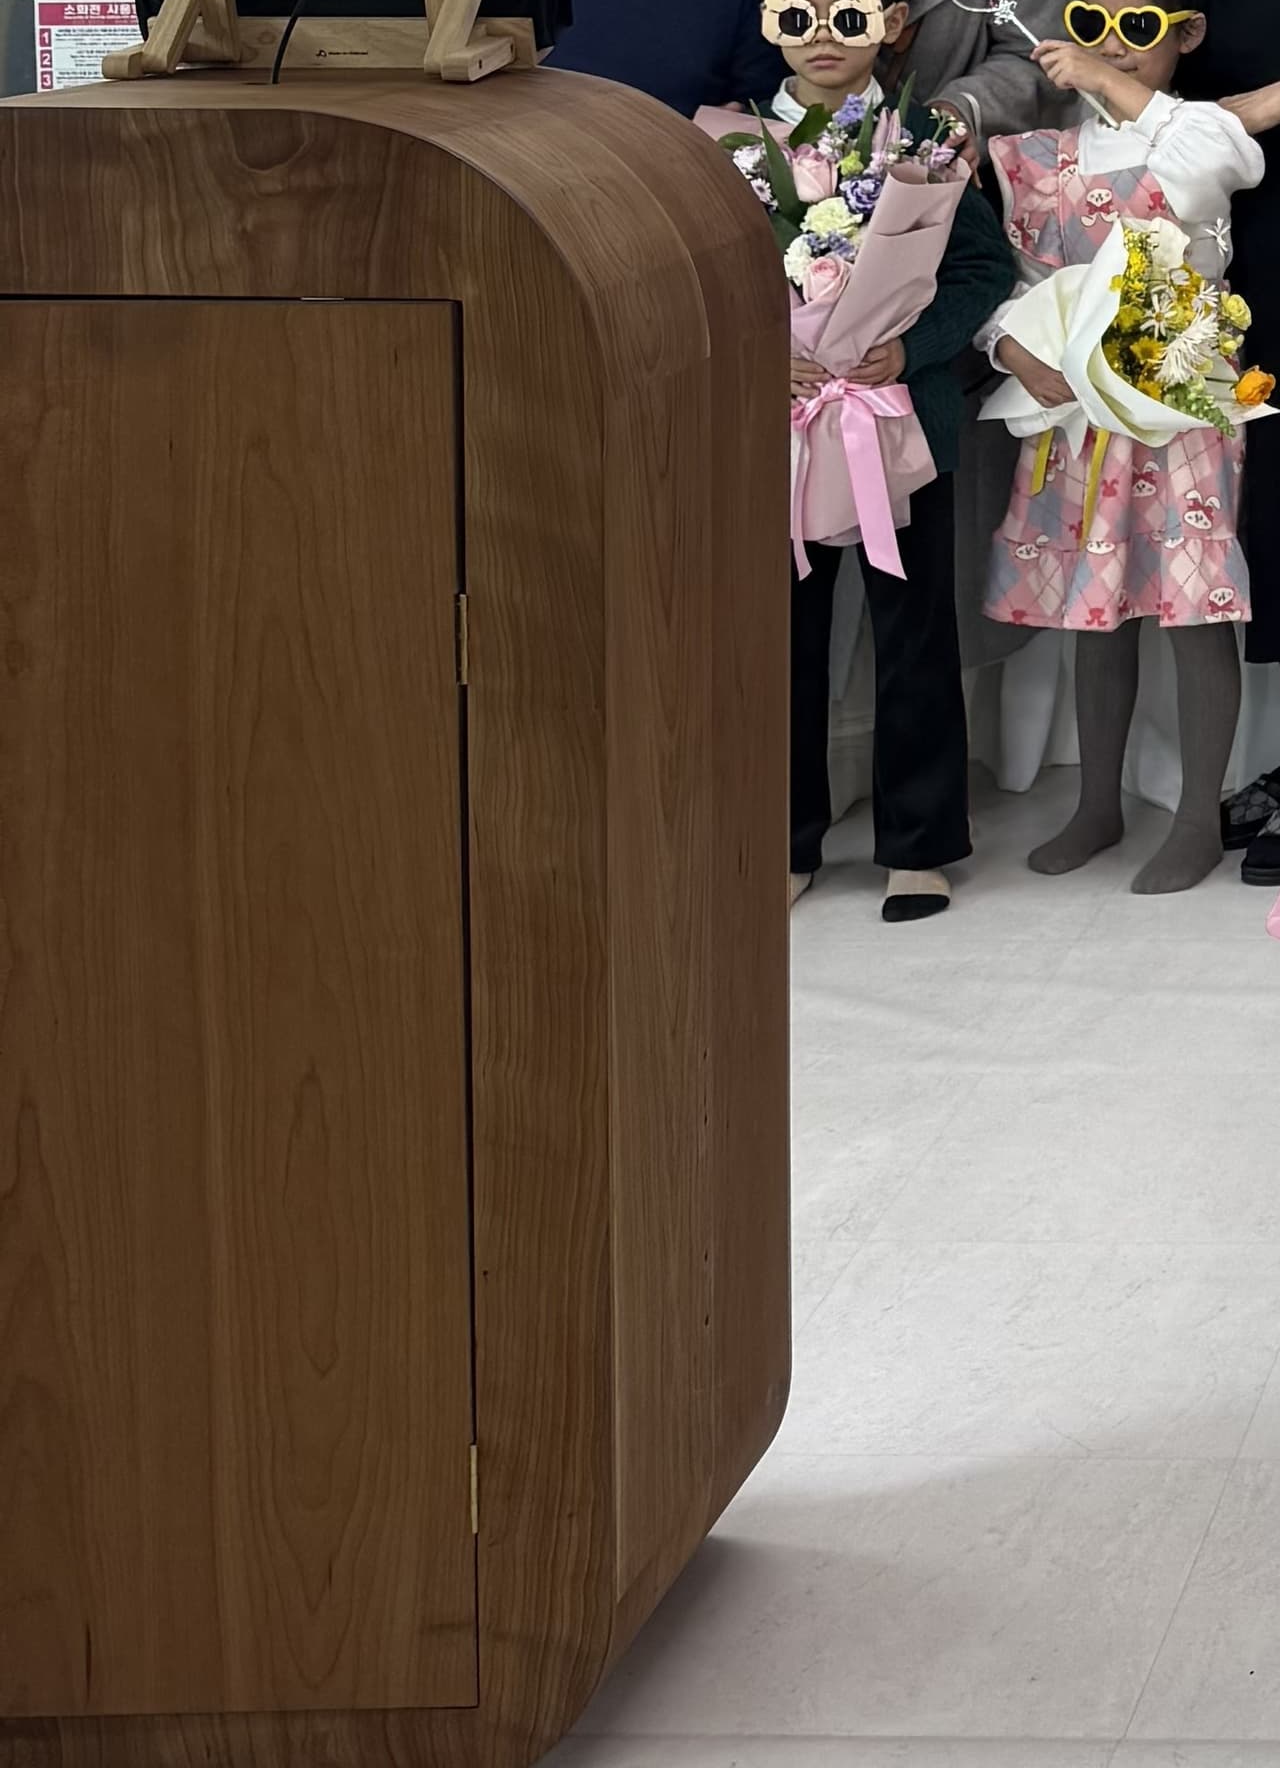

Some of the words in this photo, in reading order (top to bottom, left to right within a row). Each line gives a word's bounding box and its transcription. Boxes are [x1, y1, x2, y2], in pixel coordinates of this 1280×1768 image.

[106, 3, 137, 16] 사용
[41, 31, 50, 44] 1
[42, 53, 51, 66] 2
[42, 74, 52, 87] 3
